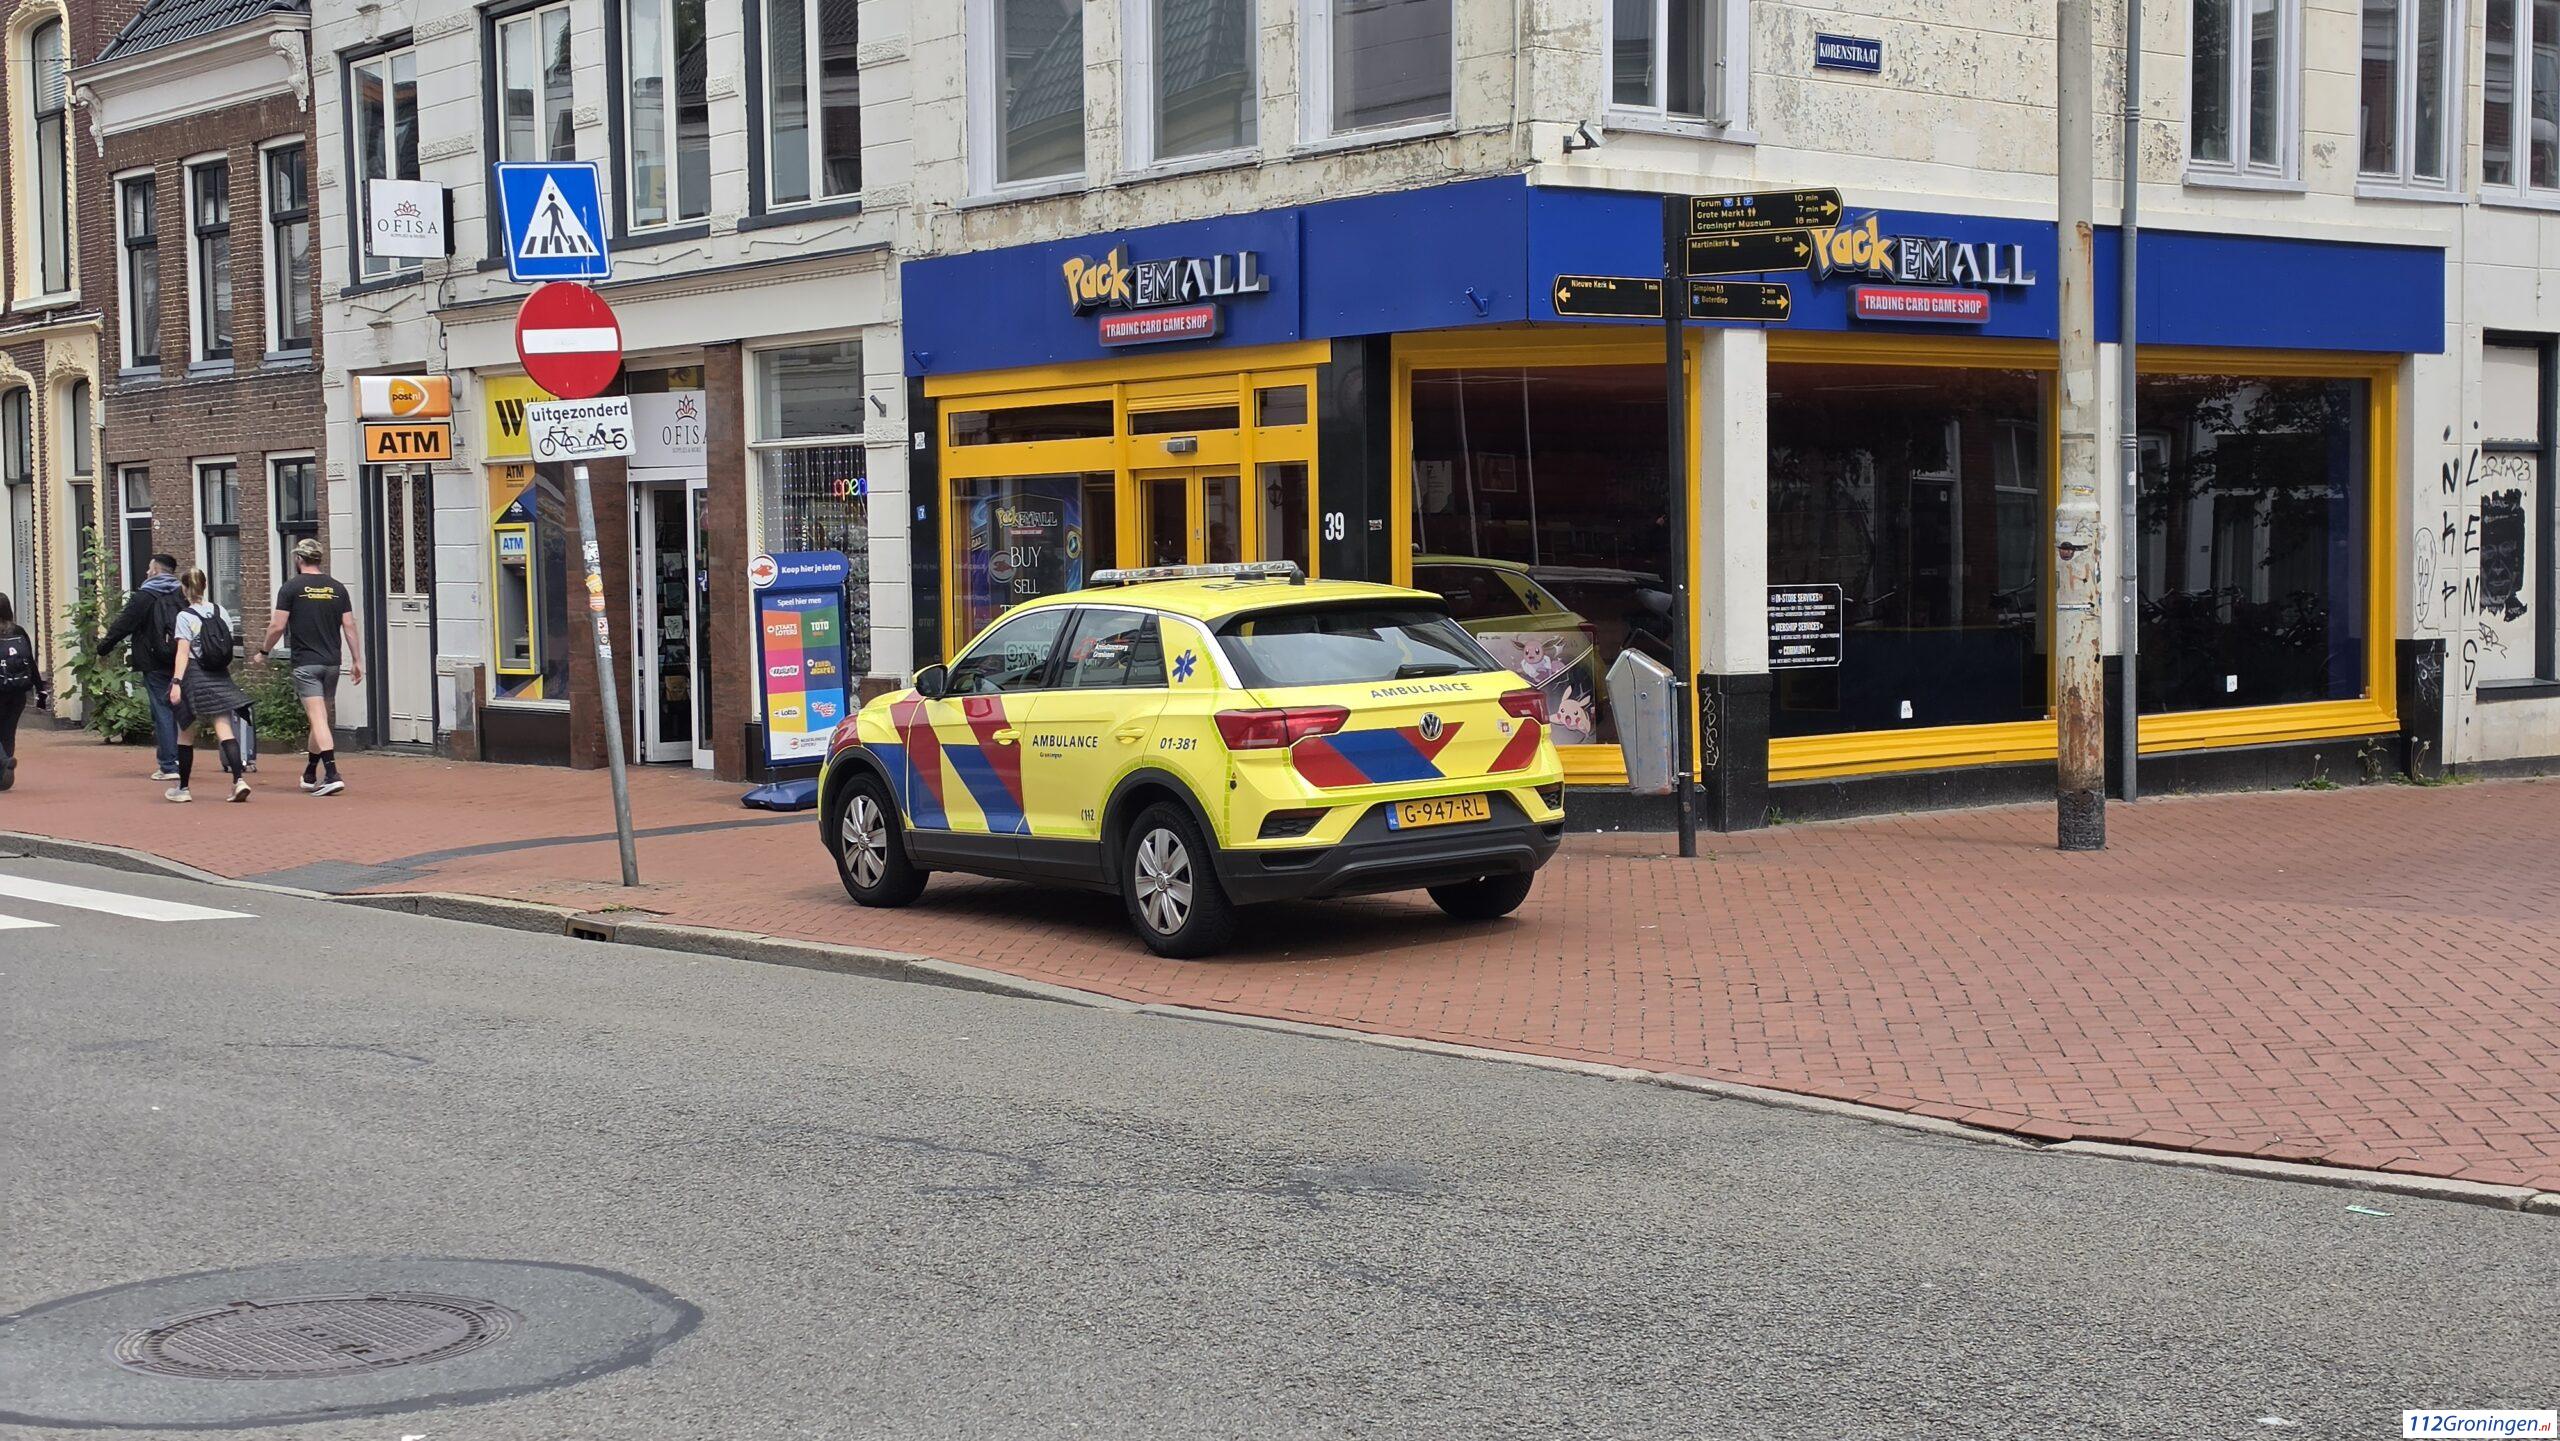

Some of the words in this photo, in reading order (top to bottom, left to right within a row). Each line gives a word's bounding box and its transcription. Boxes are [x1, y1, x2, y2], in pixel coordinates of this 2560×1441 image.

[1819, 42, 1879, 64] KORENSTRAAT
[1696, 200, 1722, 208] Forum
[1794, 194, 1804, 202] 10
[1805, 194, 1819, 202] min
[1696, 210, 1719, 219] Grote
[1721, 209, 1745, 218] Markt
[1798, 205, 1804, 213] 7
[1805, 205, 1819, 213] min
[377, 218, 438, 234] OFISA
[1697, 222, 1736, 231] Groninger
[1738, 219, 1772, 229] Museum
[1795, 217, 1805, 225] 18
[1691, 239, 1730, 249] Martinikerk
[1774, 235, 1780, 243] 8
[1781, 235, 1793, 243] min
[1811, 216, 1894, 272] Pack
[1063, 248, 1131, 306] Pack
[1571, 279, 1593, 289] Nieuwe
[1593, 280, 1607, 289] Kerk
[1692, 285, 1716, 293] Simplon
[1701, 296, 1728, 305] Boterdiep
[1864, 295, 1904, 311] TRADING
[1905, 297, 1930, 312] CARD
[1932, 298, 1957, 313] GAME
[1957, 299, 1982, 314] SHOP
[1106, 321, 1140, 338] TRADING
[1140, 319, 1162, 335] CARD
[1163, 317, 1185, 332] GAME
[1185, 314, 1208, 330] SHOP
[391, 391, 421, 402] postnl
[531, 402, 629, 424] uitgezonderd
[378, 430, 440, 454] ATM
[506, 464, 525, 479] ATM
[1325, 511, 1345, 541] 39
[503, 536, 524, 551] ATM
[1011, 546, 1041, 568] BUY
[781, 566, 800, 575] Koop
[800, 565, 814, 573] hier
[814, 564, 822, 573] je
[822, 563, 841, 572] loten
[1014, 578, 1040, 594] SELL
[777, 599, 795, 607] Speel
[795, 597, 808, 605] hier
[810, 620, 830, 631] TOTO
[1371, 682, 1473, 699] AMBULANCE
[1032, 734, 1099, 748] AMBULANCE
[1159, 737, 1198, 750] 01-381
[1084, 809, 1095, 821] 112
[1404, 797, 1485, 823] G-947-RL
